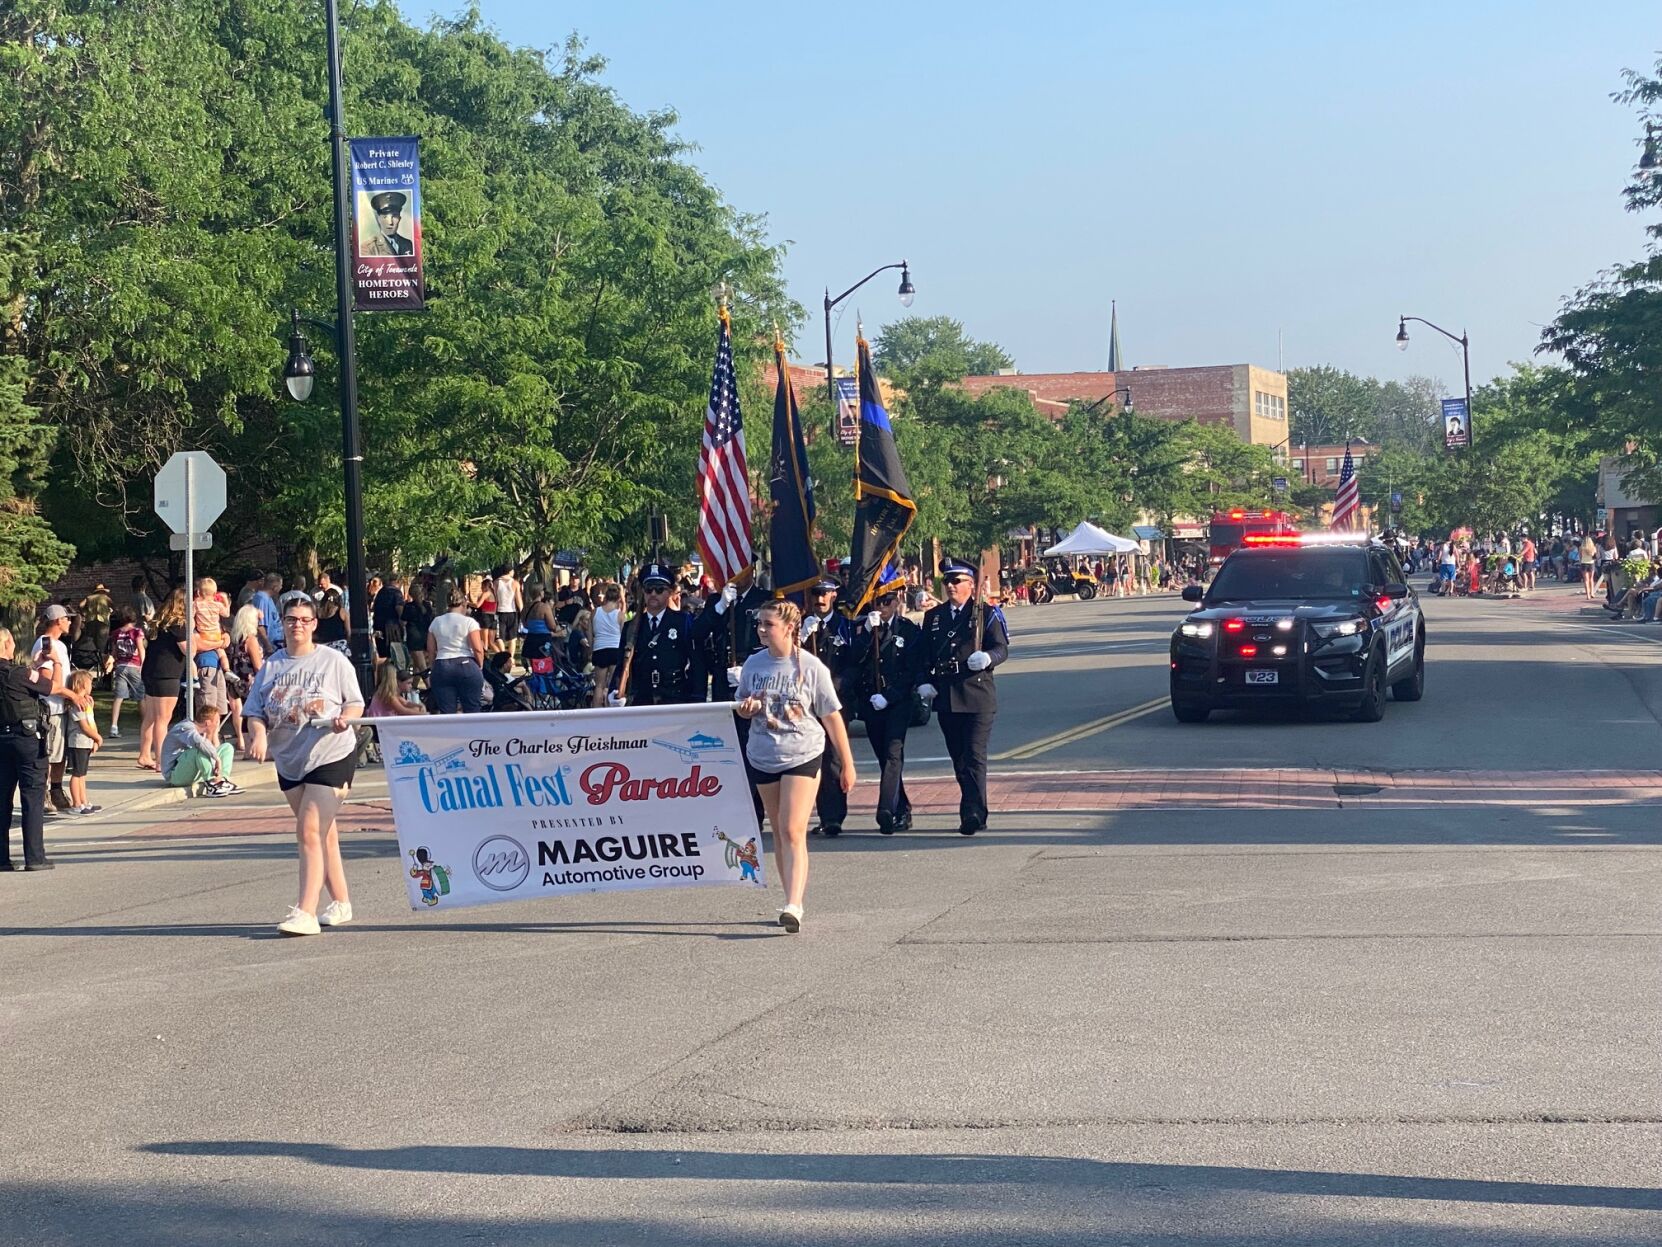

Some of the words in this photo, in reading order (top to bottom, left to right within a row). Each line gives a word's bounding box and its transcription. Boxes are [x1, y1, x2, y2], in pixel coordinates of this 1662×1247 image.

[369, 149, 399, 158] Private
[355, 161, 377, 170] Robert
[378, 160, 386, 169] C.
[356, 177, 367, 186] US
[368, 176, 398, 185] Marines
[358, 264, 373, 277] City
[375, 263, 384, 277] of
[358, 279, 418, 288] HOMETOWN
[369, 290, 409, 299] HEROES
[752, 672, 781, 690] Canal
[1256, 672, 1275, 682] 23
[469, 739, 500, 758] The
[505, 738, 563, 757] Charles
[567, 735, 648, 754] Fleishman
[418, 763, 504, 814] Canal
[505, 763, 574, 807] Fest
[579, 761, 723, 806] Parade
[532, 816, 603, 829] PRESENTED
[609, 815, 624, 825] BY
[537, 832, 701, 866] MAGUIRE
[542, 865, 646, 887] Automotive
[649, 863, 705, 882] Group
